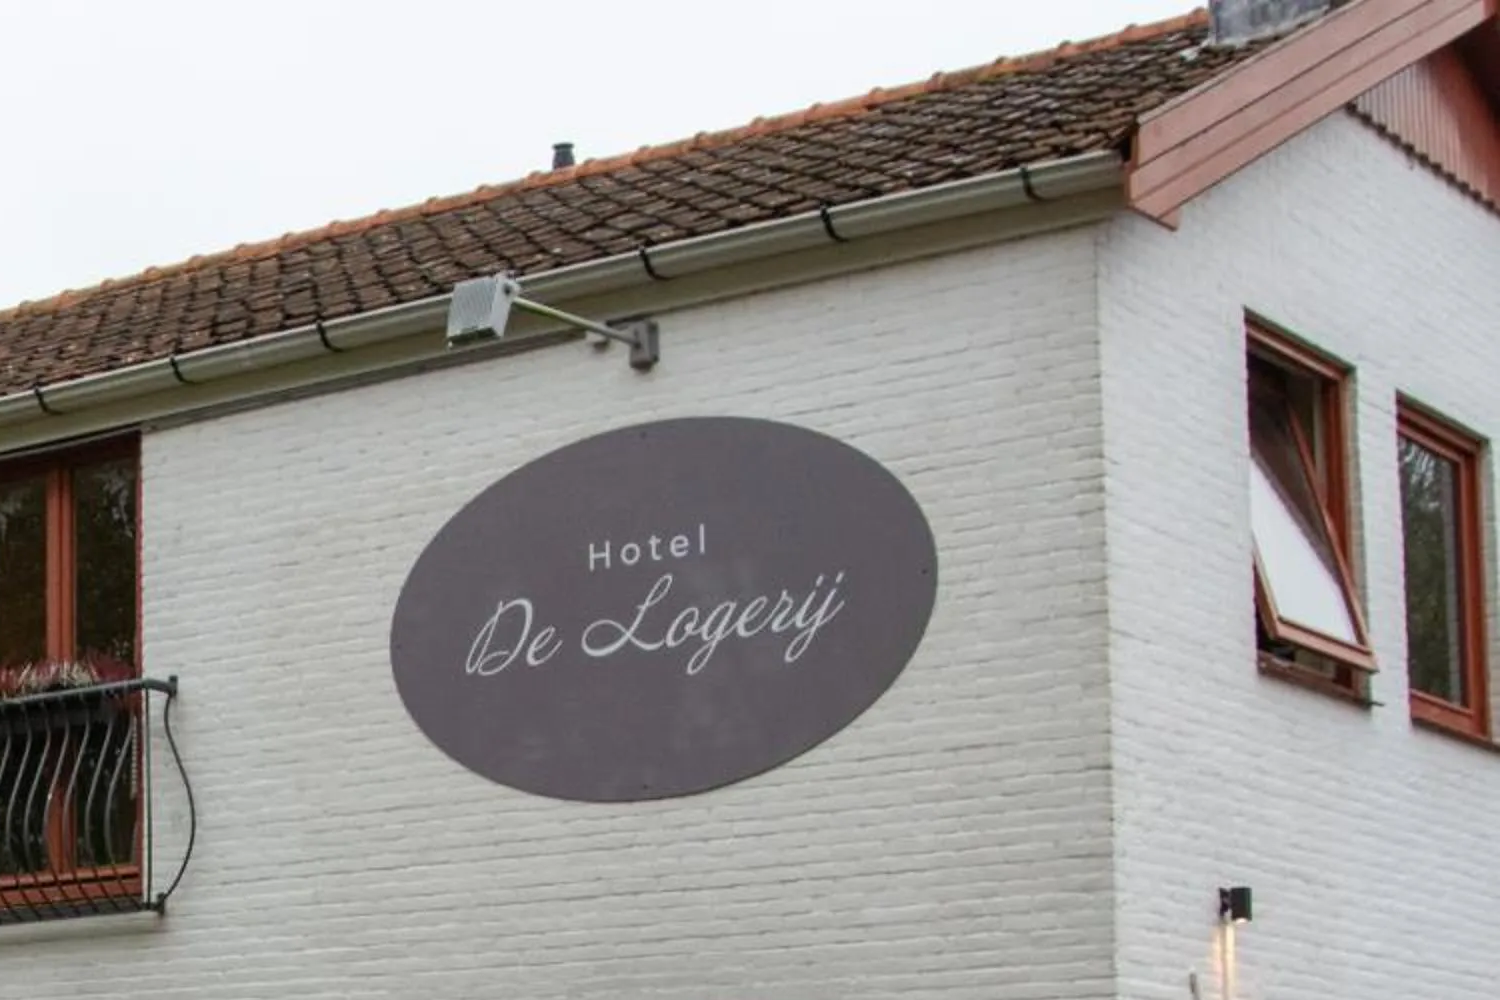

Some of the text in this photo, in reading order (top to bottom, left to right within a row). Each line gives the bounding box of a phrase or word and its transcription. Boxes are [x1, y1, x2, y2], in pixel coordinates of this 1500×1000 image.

[588, 523, 706, 570] Hotel
[465, 571, 845, 676] De Logerij
